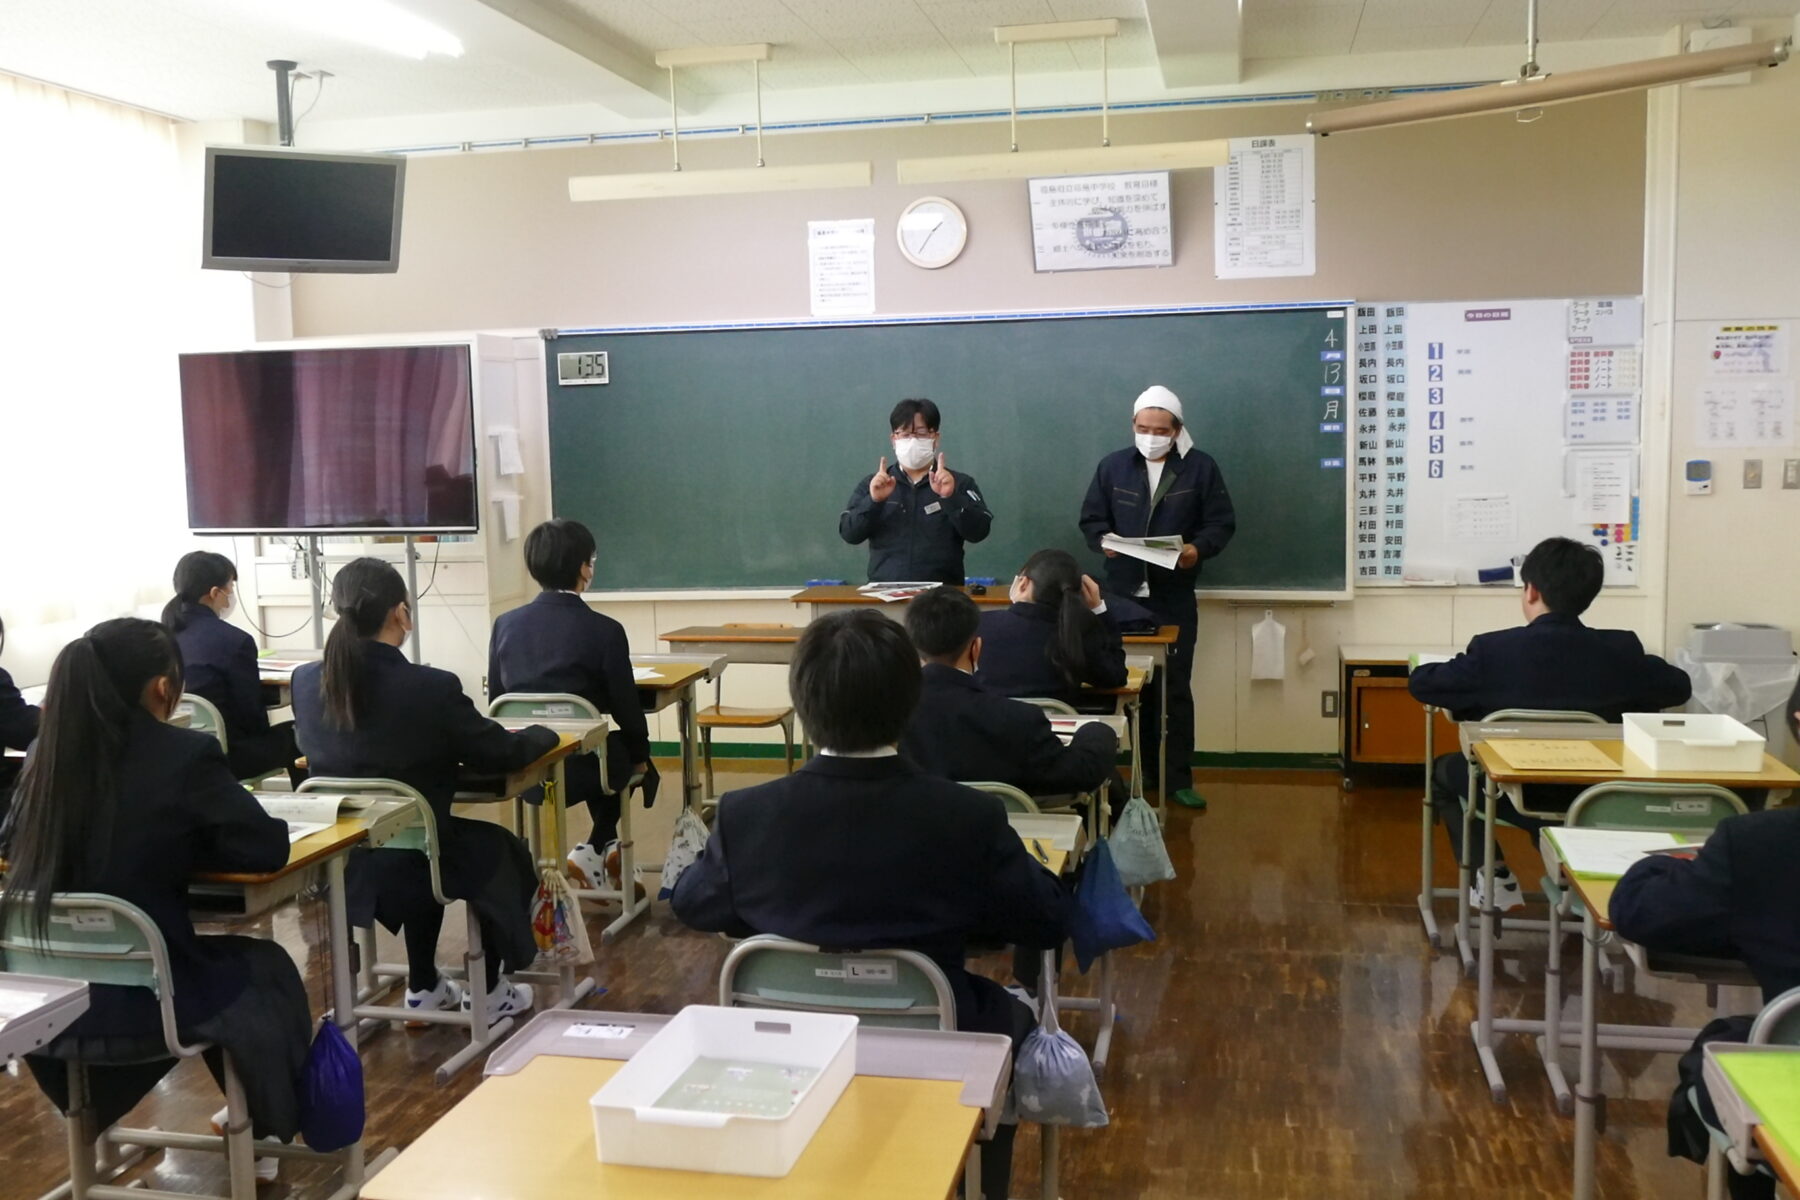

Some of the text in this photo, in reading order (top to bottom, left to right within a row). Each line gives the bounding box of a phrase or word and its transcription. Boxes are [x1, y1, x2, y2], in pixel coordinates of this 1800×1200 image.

[1251, 139, 1276, 148] 日課表
[1359, 325, 1376, 334] 上田
[1384, 325, 1402, 334] 上田
[1325, 329, 1338, 348] 4
[1433, 343, 1439, 359] 1
[1359, 358, 1376, 367] 長内
[1386, 358, 1404, 367] 長内
[1325, 363, 1341, 384] 13
[1431, 366, 1441, 381] 2
[1431, 388, 1441, 404] 3
[1323, 400, 1339, 420] 月
[1358, 408, 1376, 417] 佐藤
[1387, 408, 1405, 417] 佐藤
[1432, 412, 1441, 429] 4
[1359, 425, 1376, 433] 永井
[1388, 423, 1406, 432] 永井
[1359, 440, 1377, 450] 新山
[1386, 439, 1404, 448] 新山
[1432, 436, 1441, 453] 5
[1431, 461, 1441, 477] 6
[1359, 473, 1376, 482] 平野
[1387, 473, 1405, 482] 平野
[1359, 489, 1376, 499] 丸井
[1386, 488, 1404, 497] 丸井
[1359, 520, 1376, 529] 村田
[1386, 520, 1403, 528] 村田
[1358, 534, 1376, 543] 安田
[1385, 536, 1402, 545] 安田
[1359, 566, 1376, 575] 吉田
[1384, 566, 1401, 575] 吉田
